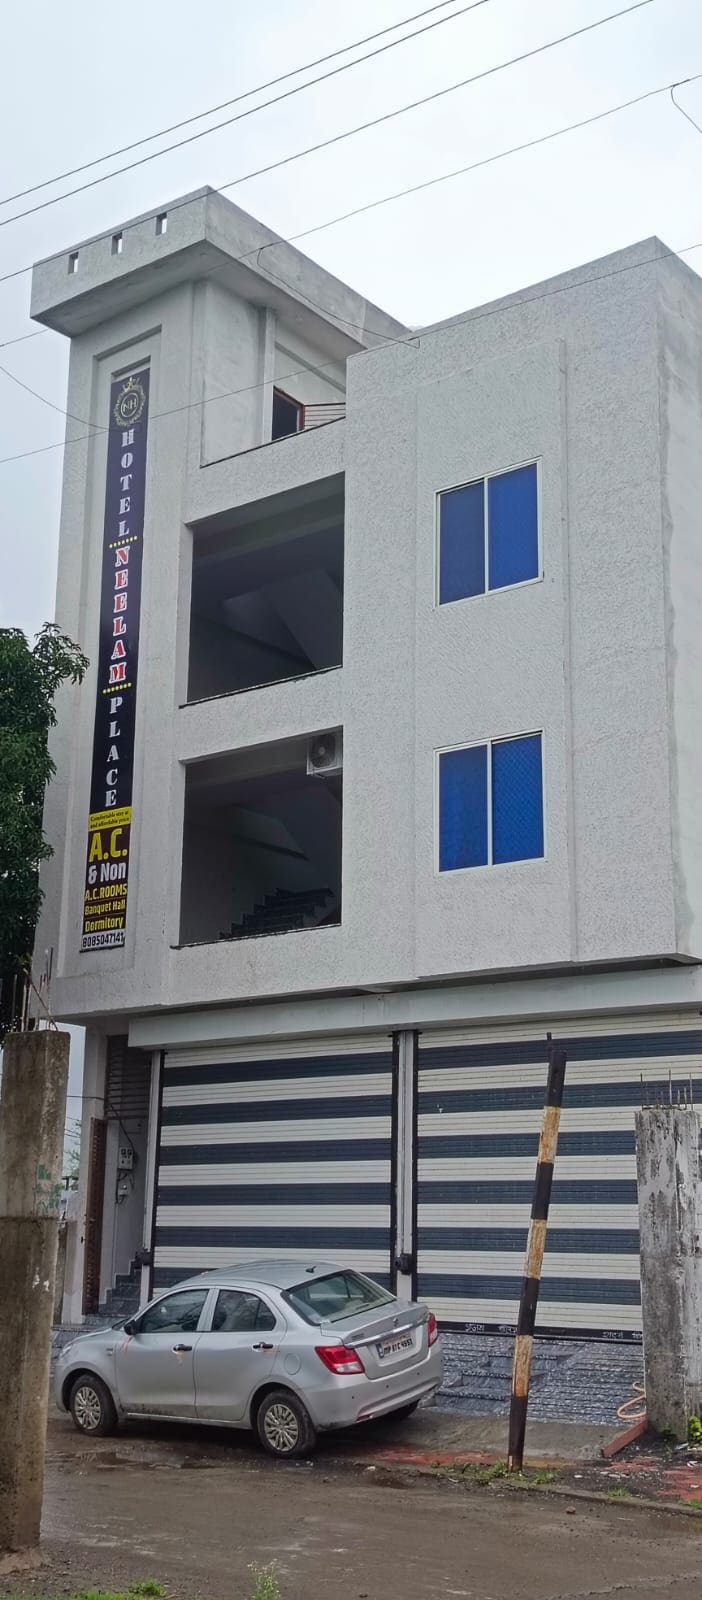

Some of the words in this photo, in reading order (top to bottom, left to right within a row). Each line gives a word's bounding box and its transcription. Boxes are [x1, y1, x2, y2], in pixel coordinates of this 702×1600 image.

[122, 398, 137, 412] NH
[118, 428, 135, 537] HOTEL
[108, 546, 131, 683] NEELAM
[105, 696, 123, 807] PLACE
[88, 828, 128, 862] A.C.
[88, 865, 97, 884] &
[100, 862, 127, 882] Non
[84, 902, 112, 915] Banquet
[112, 899, 126, 911] Hall
[85, 916, 124, 932] Dormitory
